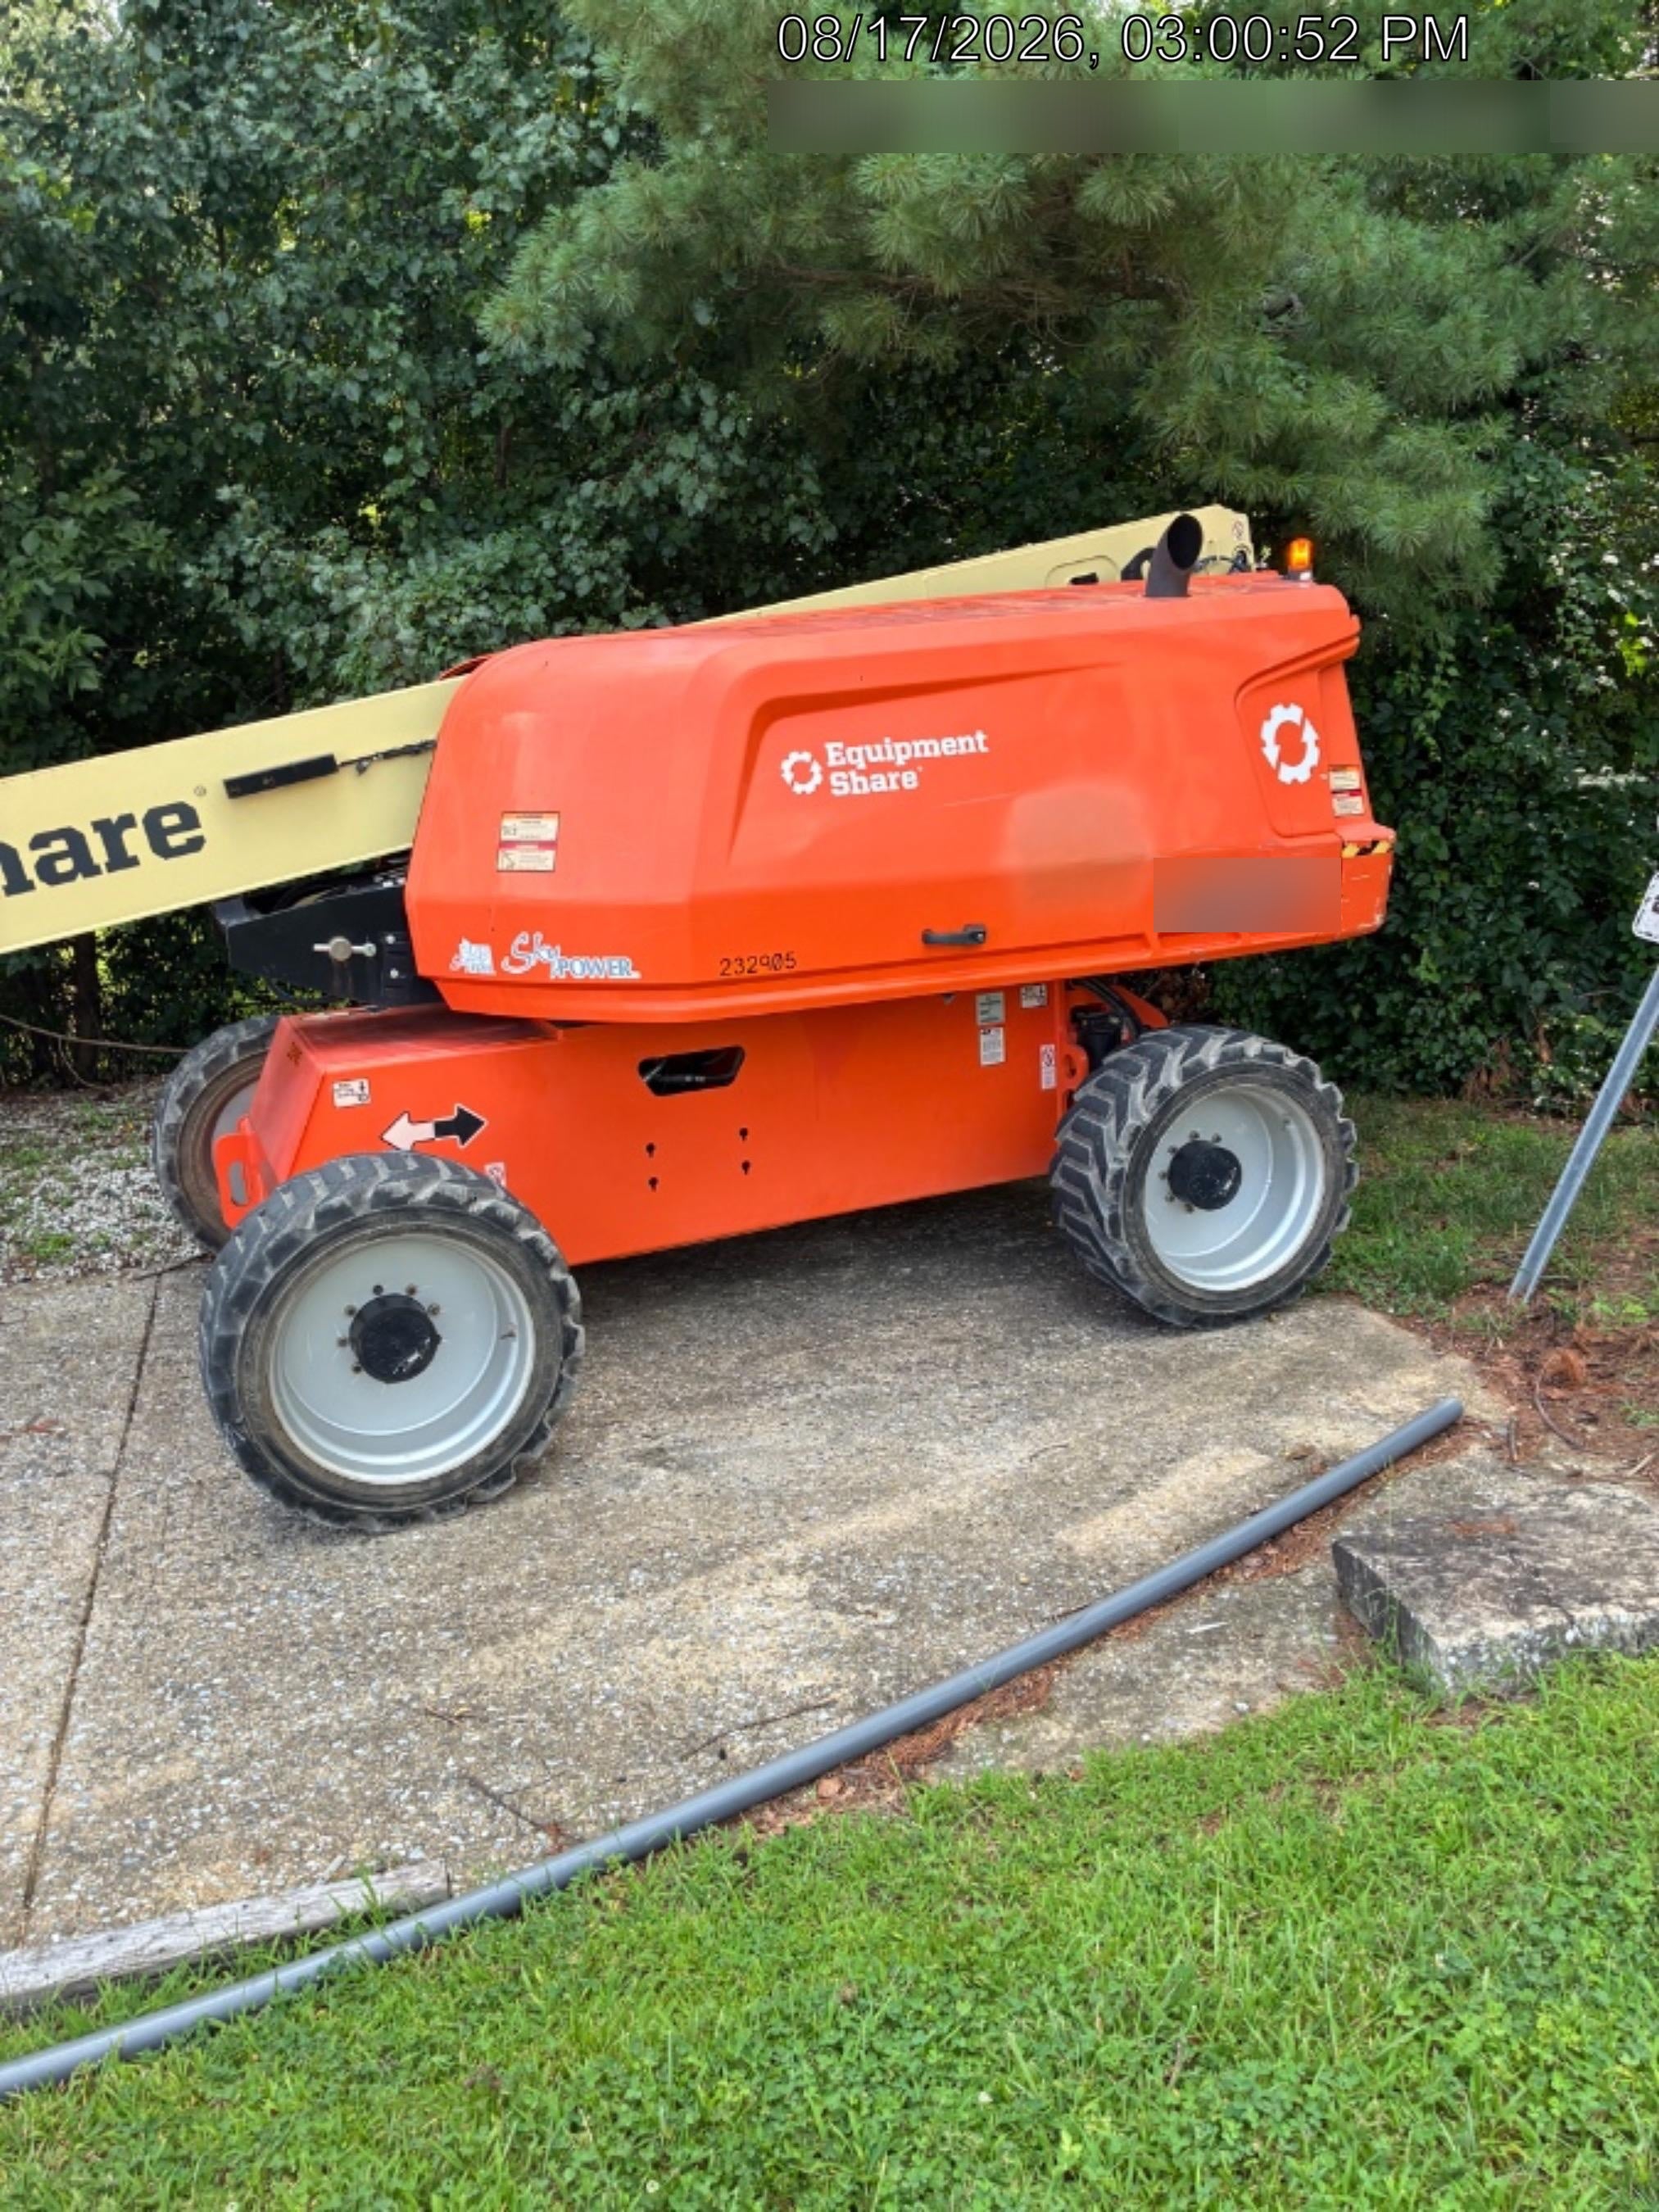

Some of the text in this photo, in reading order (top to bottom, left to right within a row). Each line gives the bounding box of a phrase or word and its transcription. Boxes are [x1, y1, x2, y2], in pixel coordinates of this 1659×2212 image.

[824, 730, 989, 769] Equipment
[830, 767, 919, 796] Share
[719, 950, 797, 977] 232905
